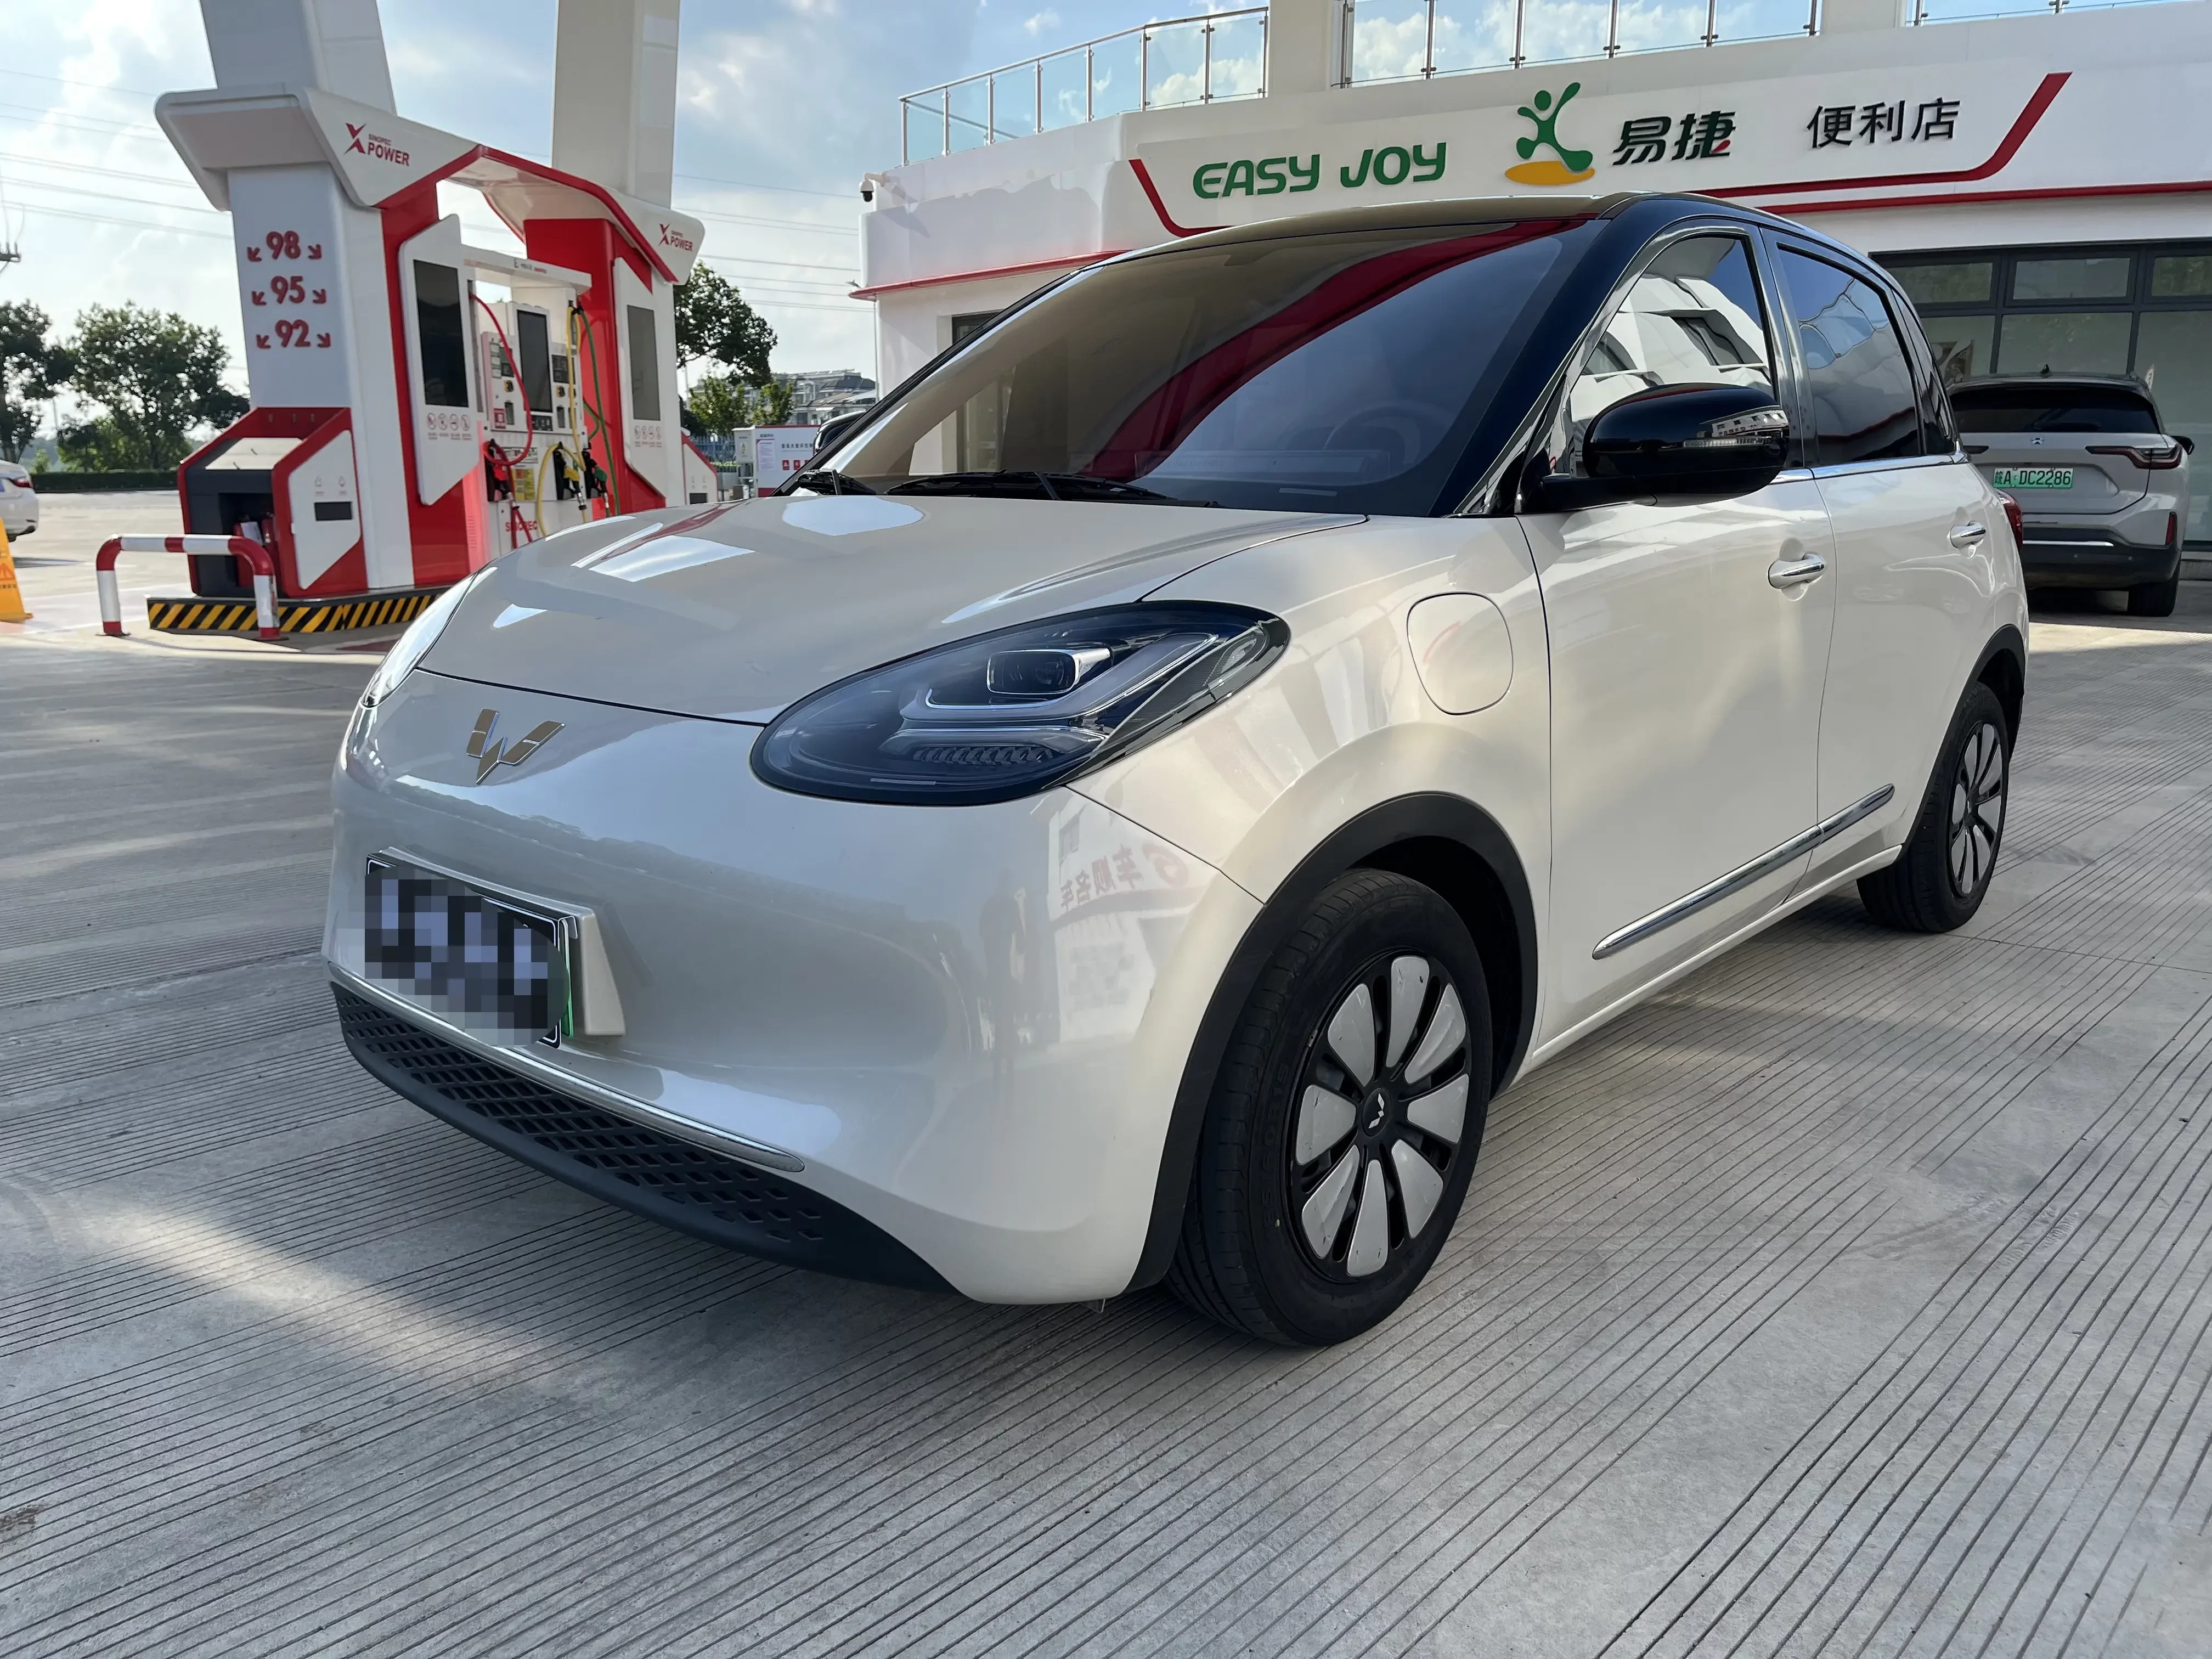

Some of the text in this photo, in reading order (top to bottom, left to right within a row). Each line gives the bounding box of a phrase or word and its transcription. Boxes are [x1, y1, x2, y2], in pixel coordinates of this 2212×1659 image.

[1612, 110, 1736, 166] 易捷
[1807, 98, 1961, 149] 便利店
[368, 142, 410, 167] POWER
[1193, 142, 1447, 199] EASY JOY
[266, 230, 301, 260] 98
[270, 275, 306, 304] 95
[275, 319, 311, 348] 92
